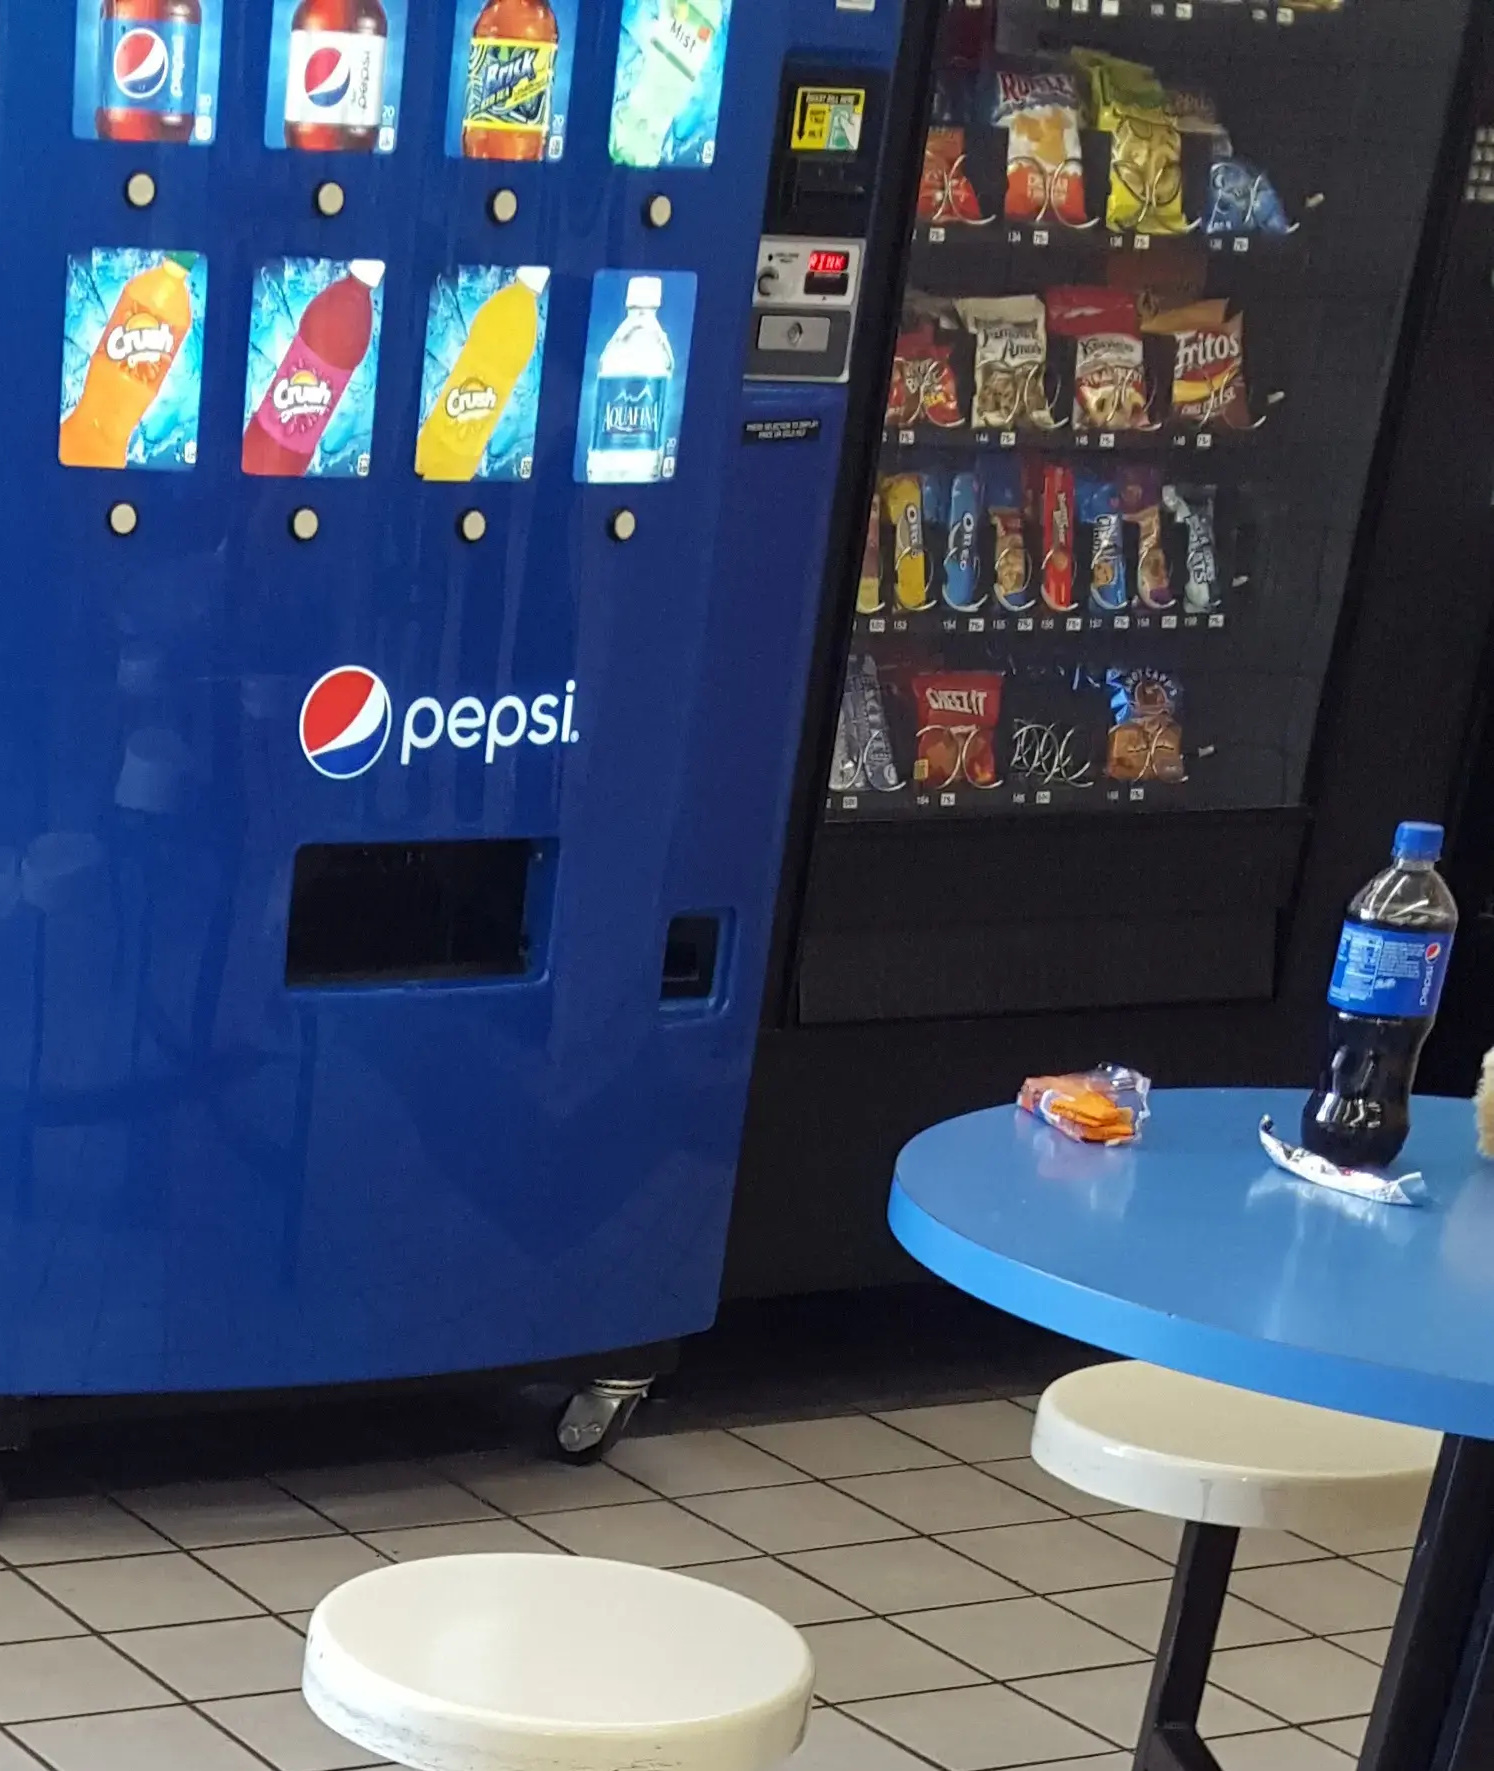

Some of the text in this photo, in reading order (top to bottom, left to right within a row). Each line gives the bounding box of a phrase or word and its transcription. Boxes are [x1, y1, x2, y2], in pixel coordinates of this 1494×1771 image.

[670, 19, 697, 54] Mist
[107, 323, 174, 361] Crush
[1175, 330, 1240, 379] Fritos
[273, 379, 332, 410] Crush
[445, 386, 497, 418] Crush
[602, 401, 659, 433] AQUAFINA
[959, 512, 975, 571] OREO
[400, 679, 576, 765] pepsi
